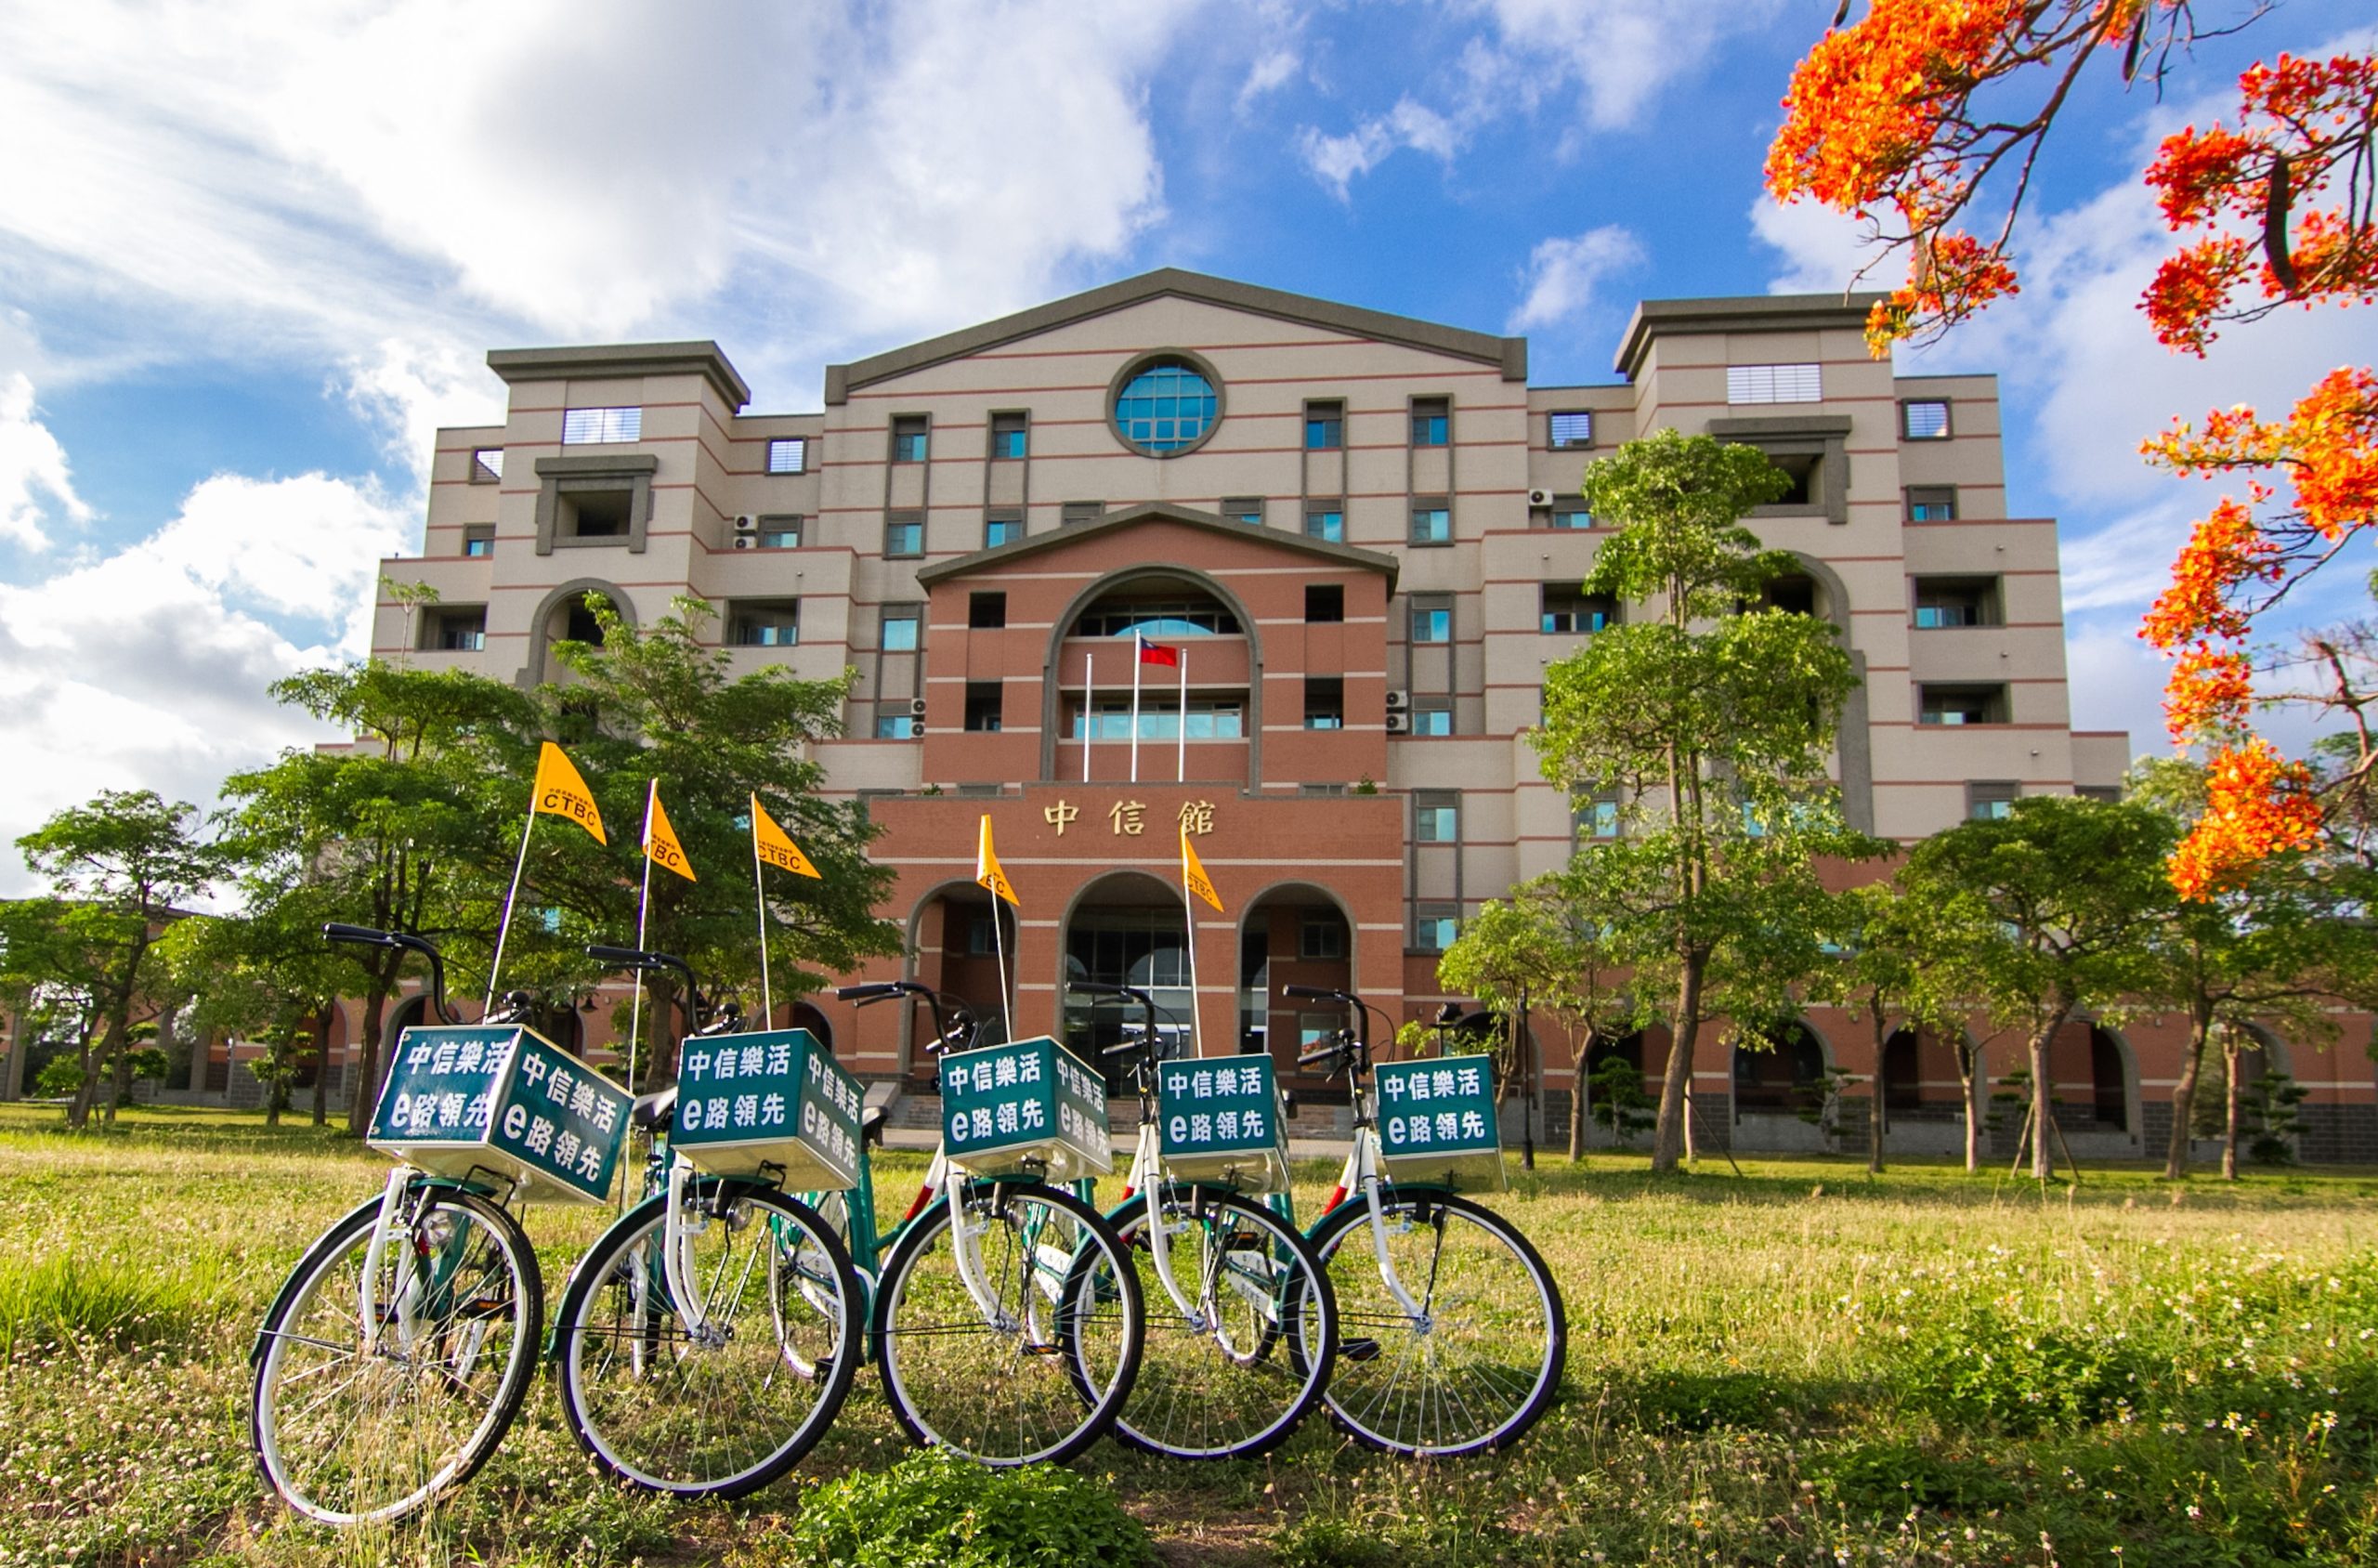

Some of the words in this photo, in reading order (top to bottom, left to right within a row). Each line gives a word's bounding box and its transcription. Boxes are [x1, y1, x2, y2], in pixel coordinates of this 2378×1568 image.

[543, 793, 596, 826] CTBC
[1044, 800, 1216, 836] 中信館
[758, 845, 801, 869] CTBC
[407, 1039, 512, 1076] 中信樂活
[687, 1043, 790, 1081] 中信樂活
[948, 1052, 1040, 1096] 中信樂活
[521, 1053, 617, 1134] 中信樂活
[808, 1052, 859, 1125] 中信樂活
[1168, 1066, 1262, 1100] 中信樂活
[1384, 1067, 1480, 1102] 中信樂活
[391, 1091, 489, 1129] e路領先
[682, 1092, 785, 1130] e路領先
[951, 1098, 1044, 1143] e路領先
[1169, 1109, 1264, 1143] e路領先
[1388, 1110, 1485, 1143] e路領先
[503, 1103, 602, 1183] e路領先
